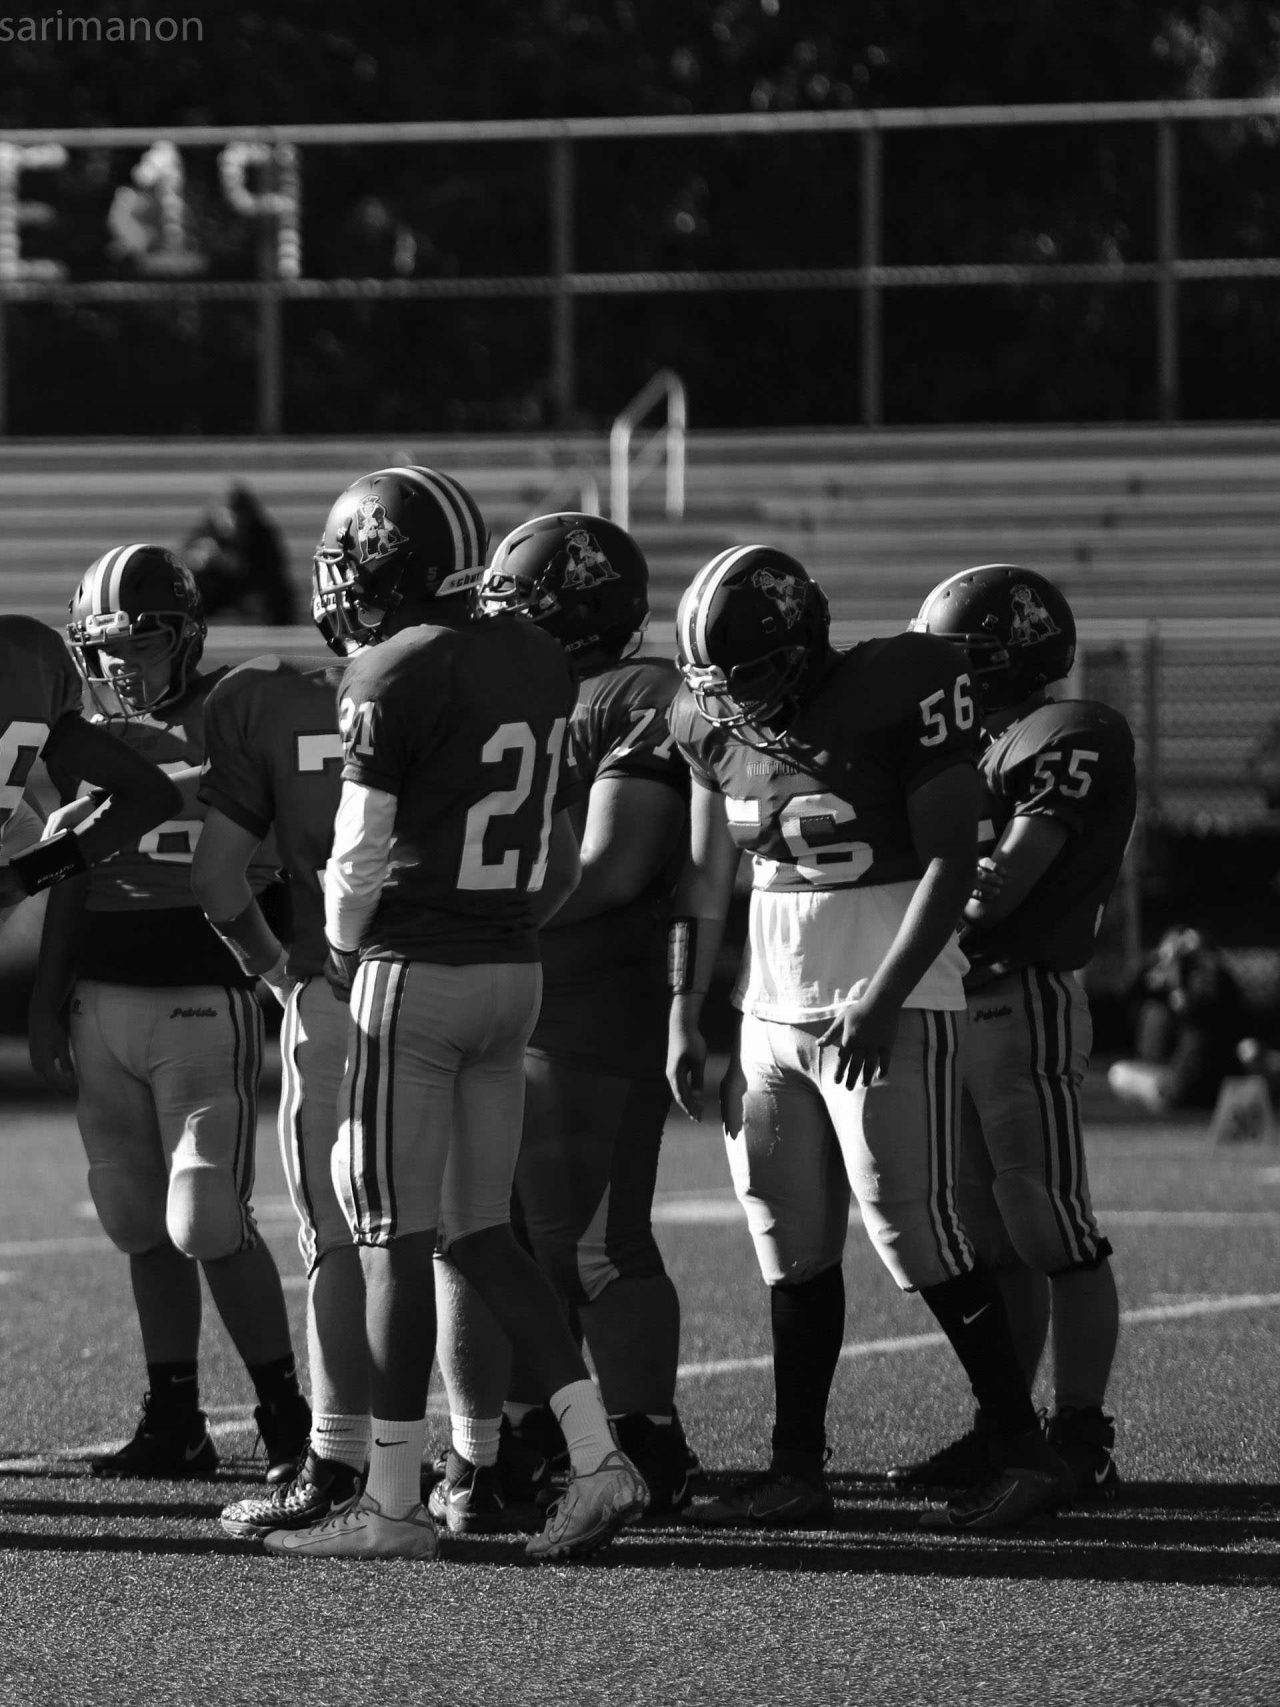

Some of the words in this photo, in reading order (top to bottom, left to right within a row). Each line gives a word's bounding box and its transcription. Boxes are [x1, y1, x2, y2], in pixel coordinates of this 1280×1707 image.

[919, 672, 975, 748] 56
[456, 716, 566, 893] 21
[1029, 749, 1100, 800] 55
